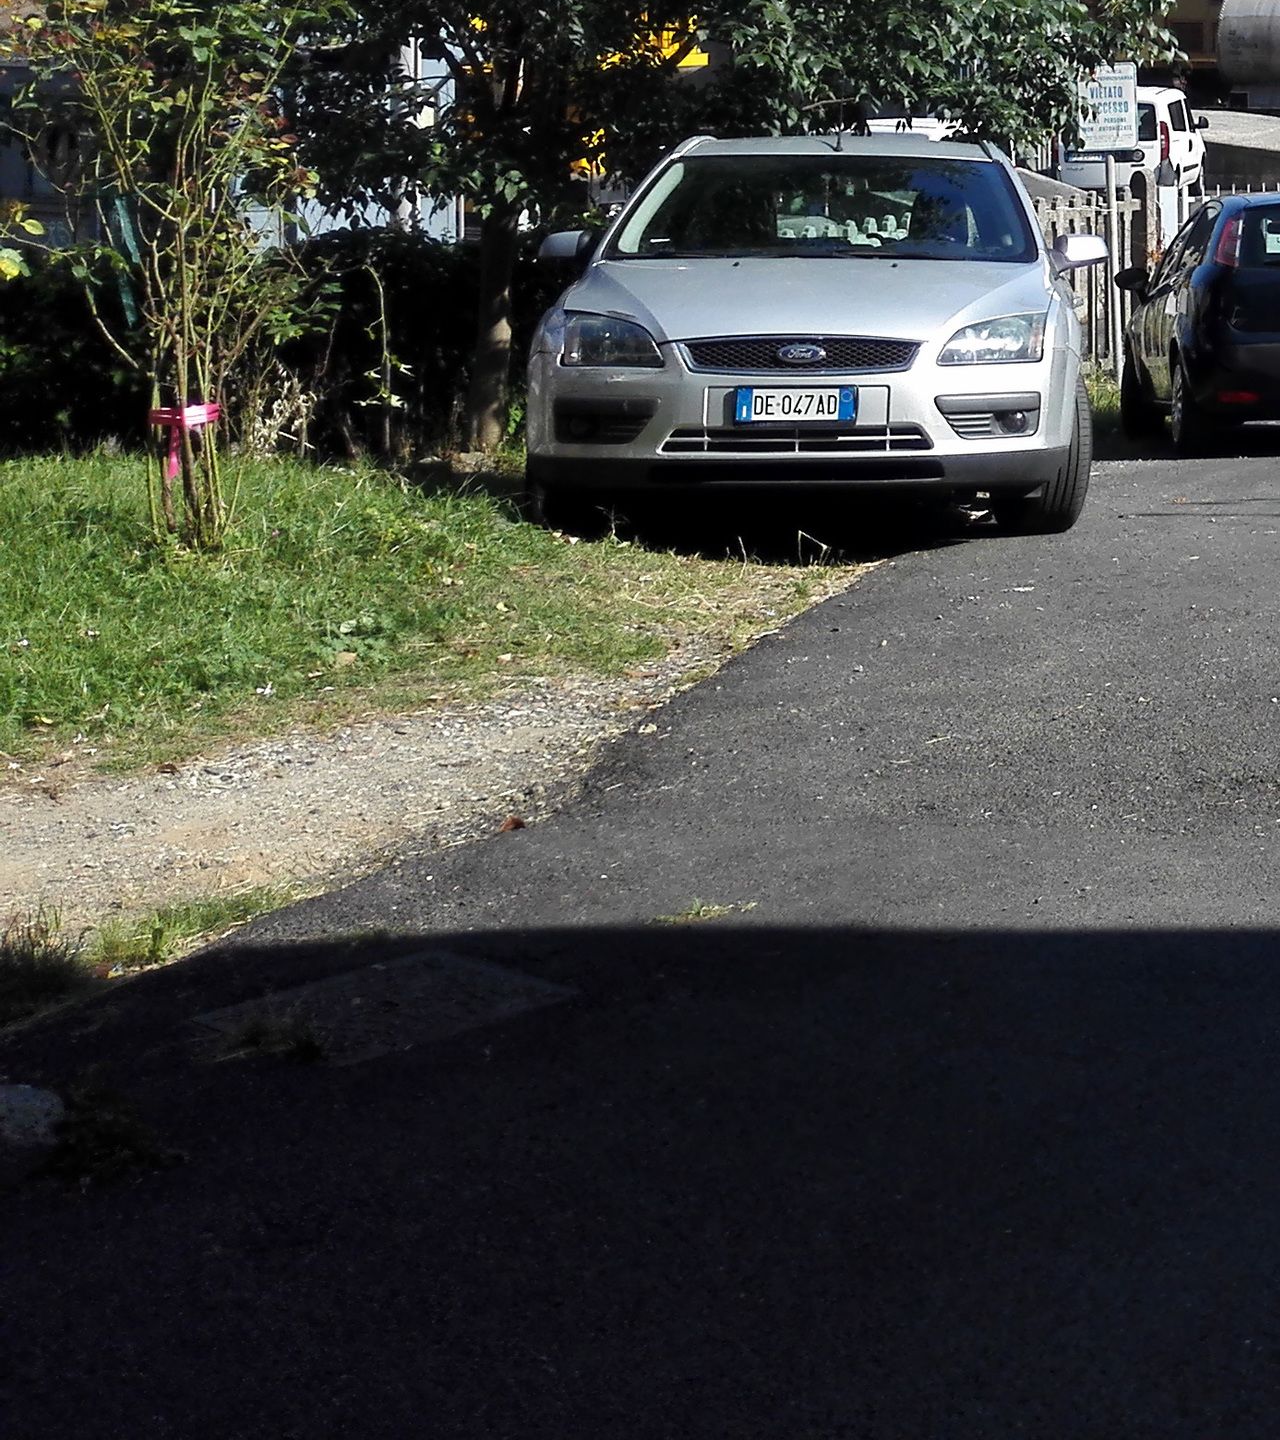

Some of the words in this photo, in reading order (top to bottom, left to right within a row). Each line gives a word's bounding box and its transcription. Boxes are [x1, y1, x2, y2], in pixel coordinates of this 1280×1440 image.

[1089, 86, 1123, 100] VIETATO
[1092, 101, 1129, 115] CCESSO
[787, 348, 813, 359] Ford
[753, 395, 776, 415] DE
[781, 394, 838, 415] 047AD
